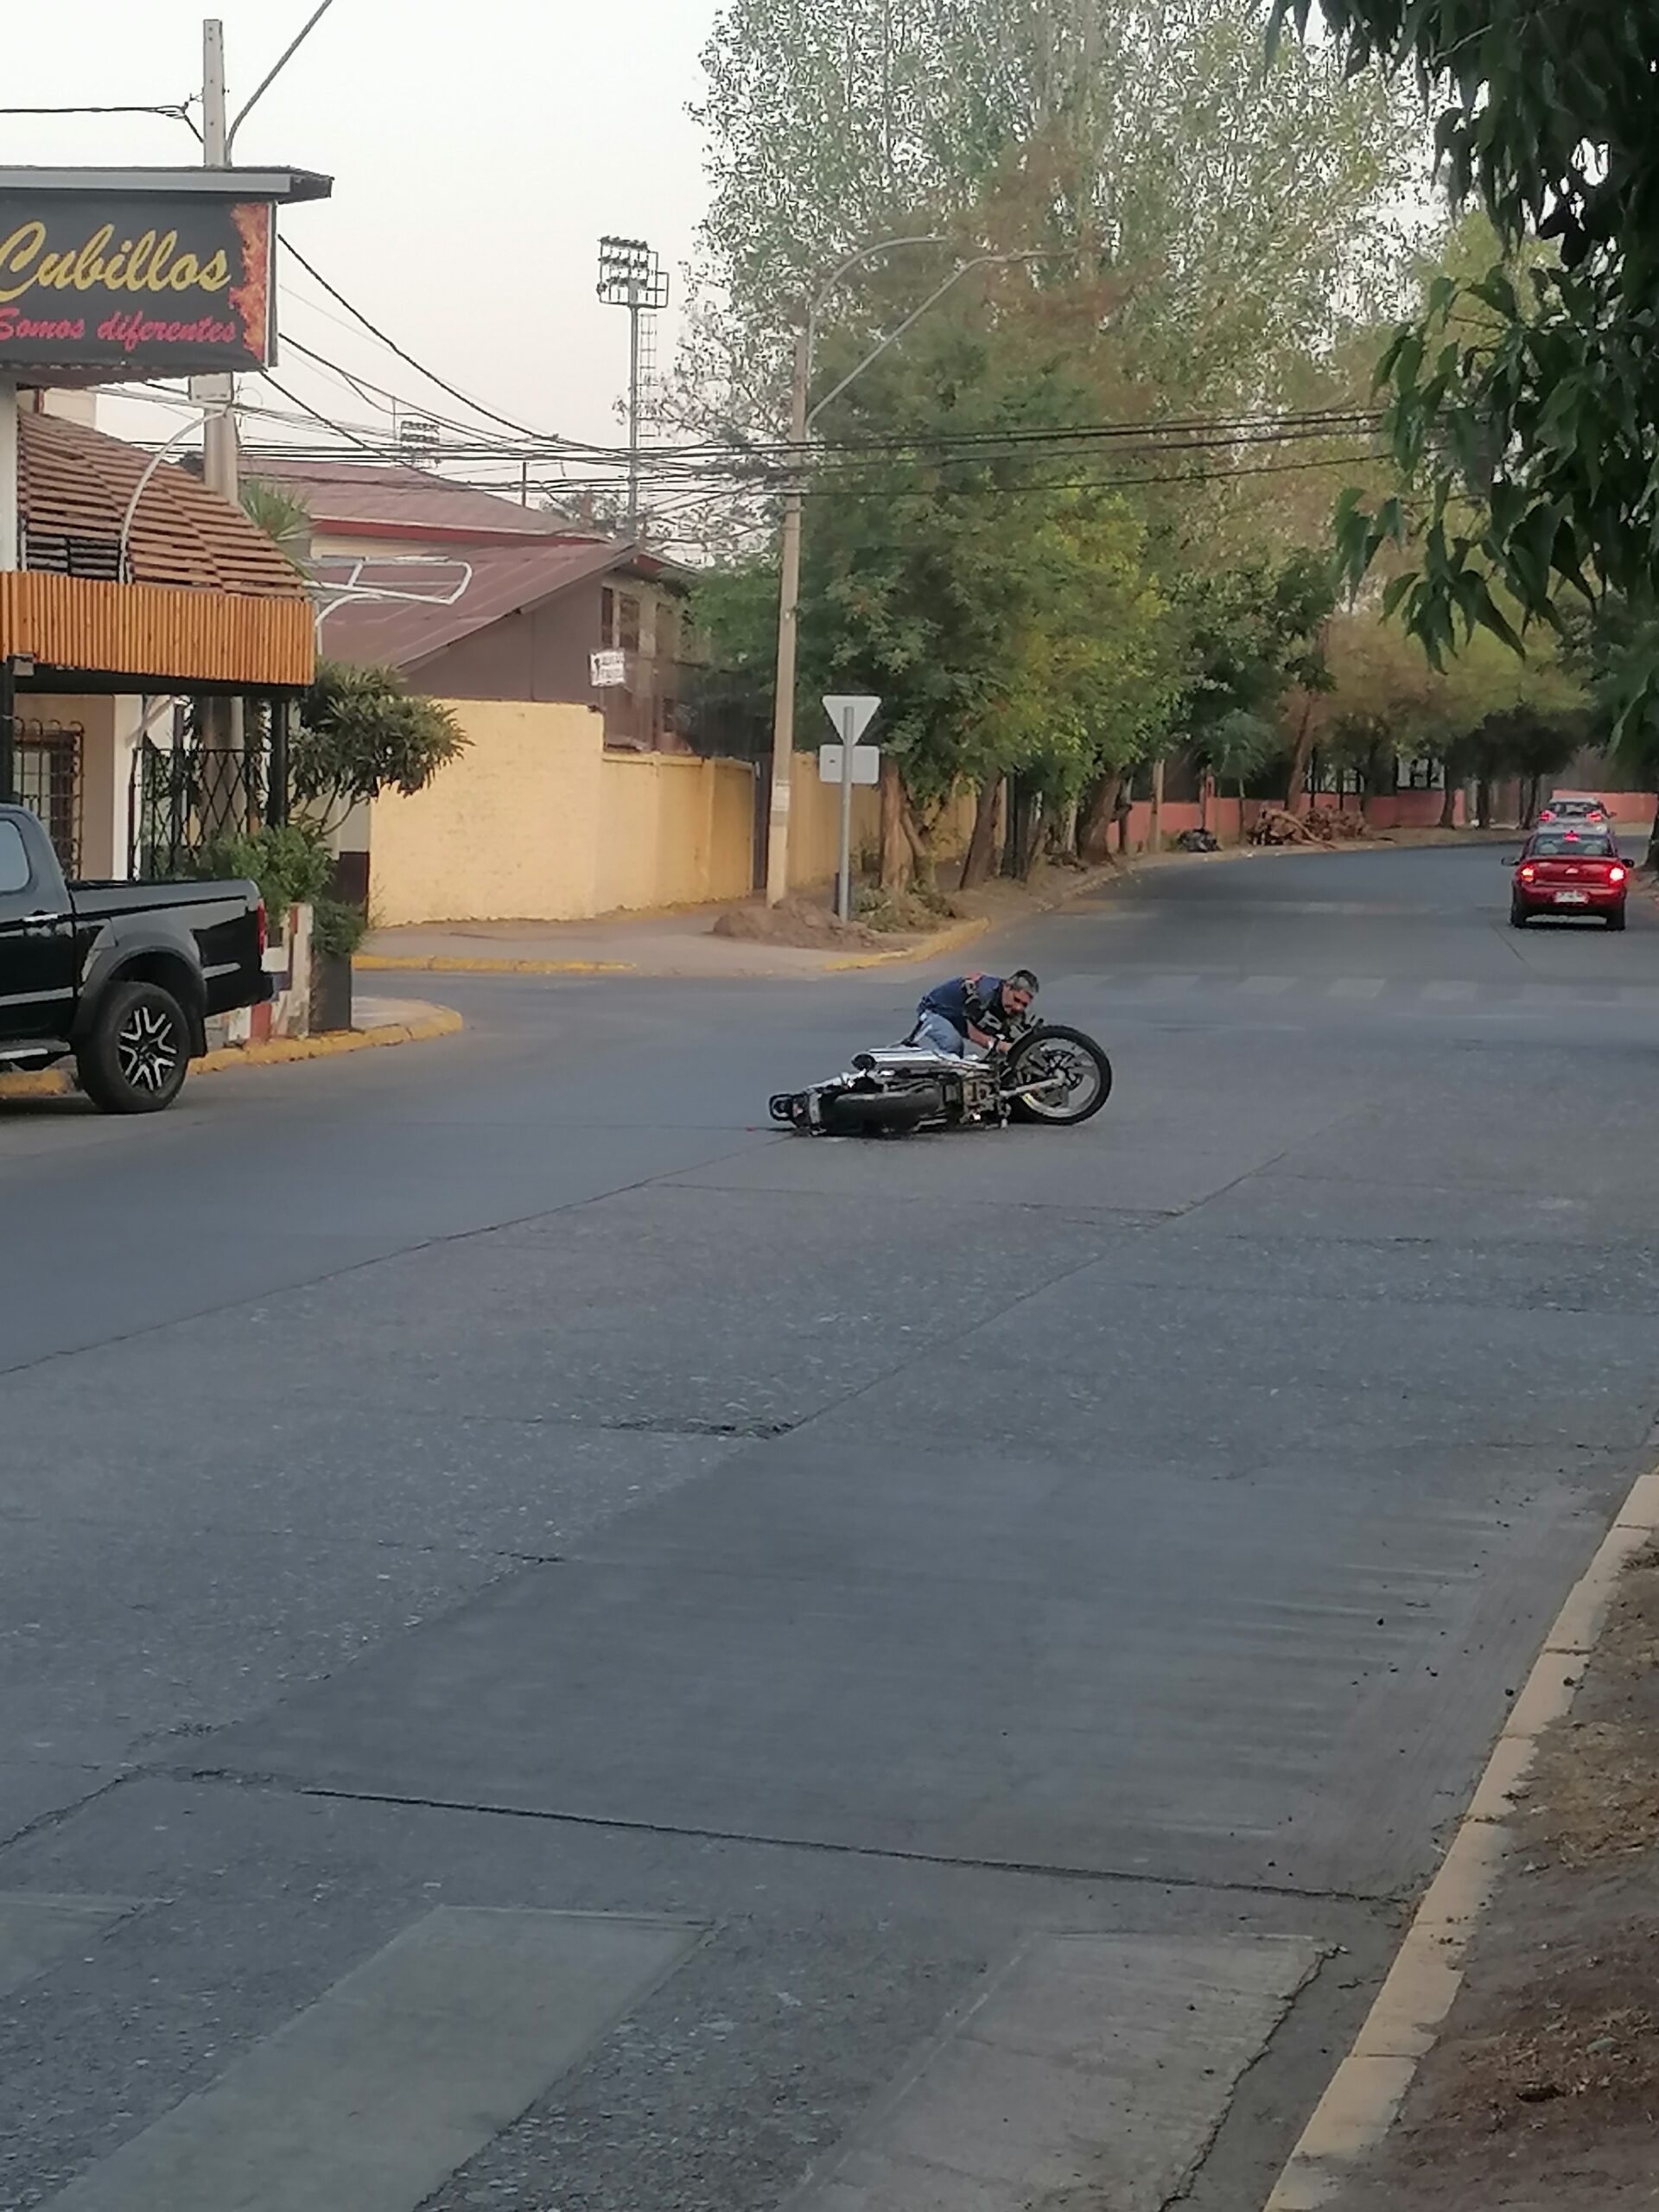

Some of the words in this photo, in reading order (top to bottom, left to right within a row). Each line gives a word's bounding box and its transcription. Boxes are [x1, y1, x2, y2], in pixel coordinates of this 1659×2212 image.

[0, 220, 232, 302] Cubillos
[0, 307, 86, 340] Somos
[97, 309, 236, 353] diferentes
